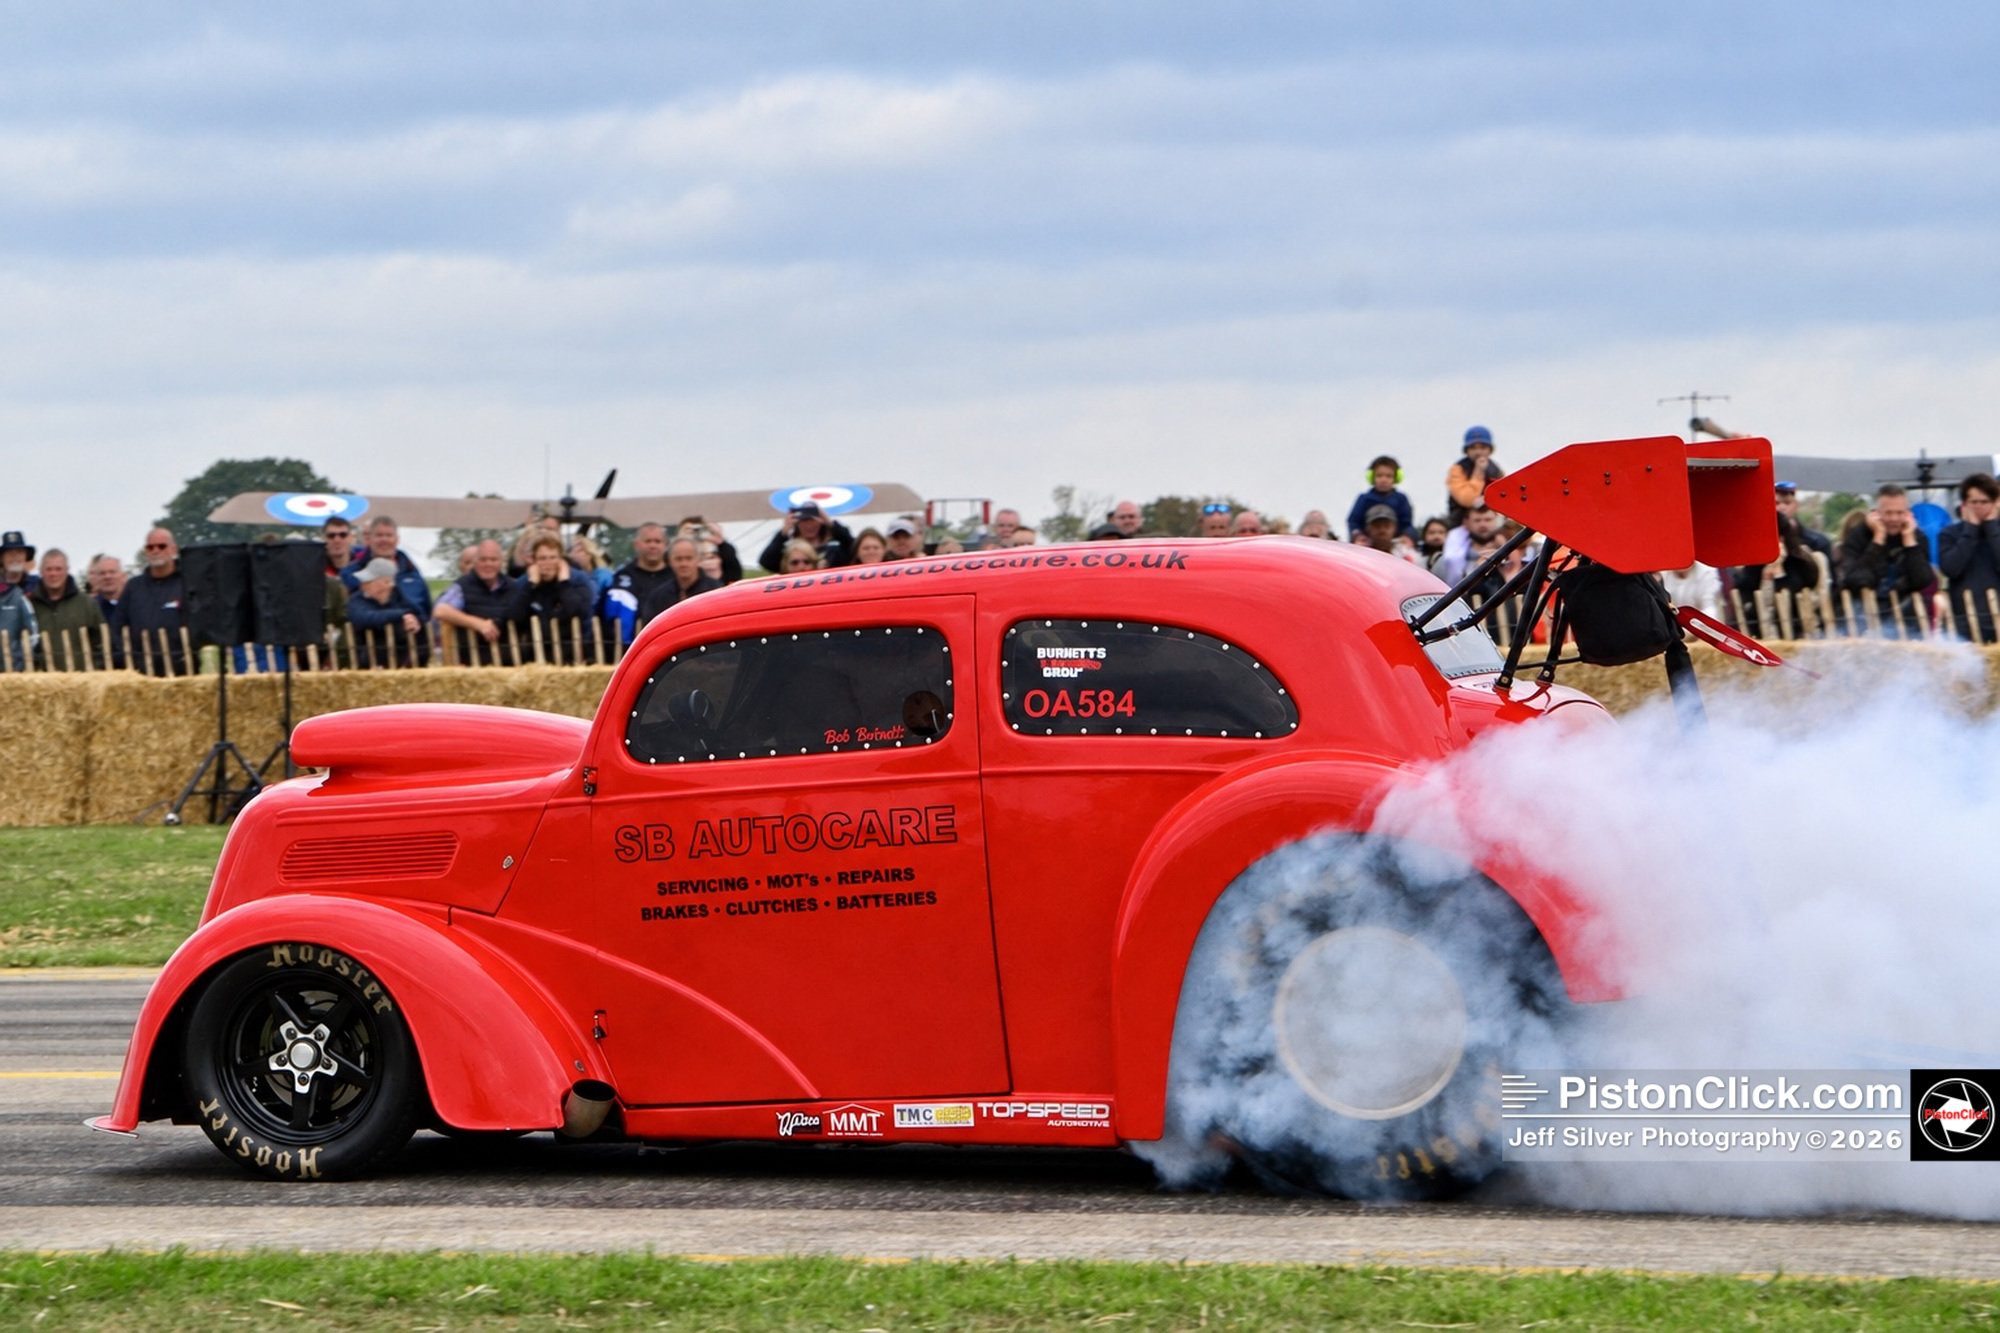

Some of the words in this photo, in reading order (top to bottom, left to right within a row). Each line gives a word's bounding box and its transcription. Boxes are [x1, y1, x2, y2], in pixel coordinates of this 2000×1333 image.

[1023, 689, 1136, 718] OA584
[824, 728, 850, 745] Bob
[614, 823, 675, 863] SB
[688, 805, 958, 859] AUTOCARE
[657, 877, 748, 896] SERVICING
[767, 873, 819, 889] MOT's
[837, 867, 915, 885] REPAIRS
[641, 904, 709, 921] BRAKES
[726, 898, 818, 916] CLUTCHES
[836, 891, 938, 910] BATTERIES
[830, 1112, 881, 1131] MMT
[896, 1108, 933, 1121] TMC
[977, 1102, 1110, 1119] TOPSPEED
